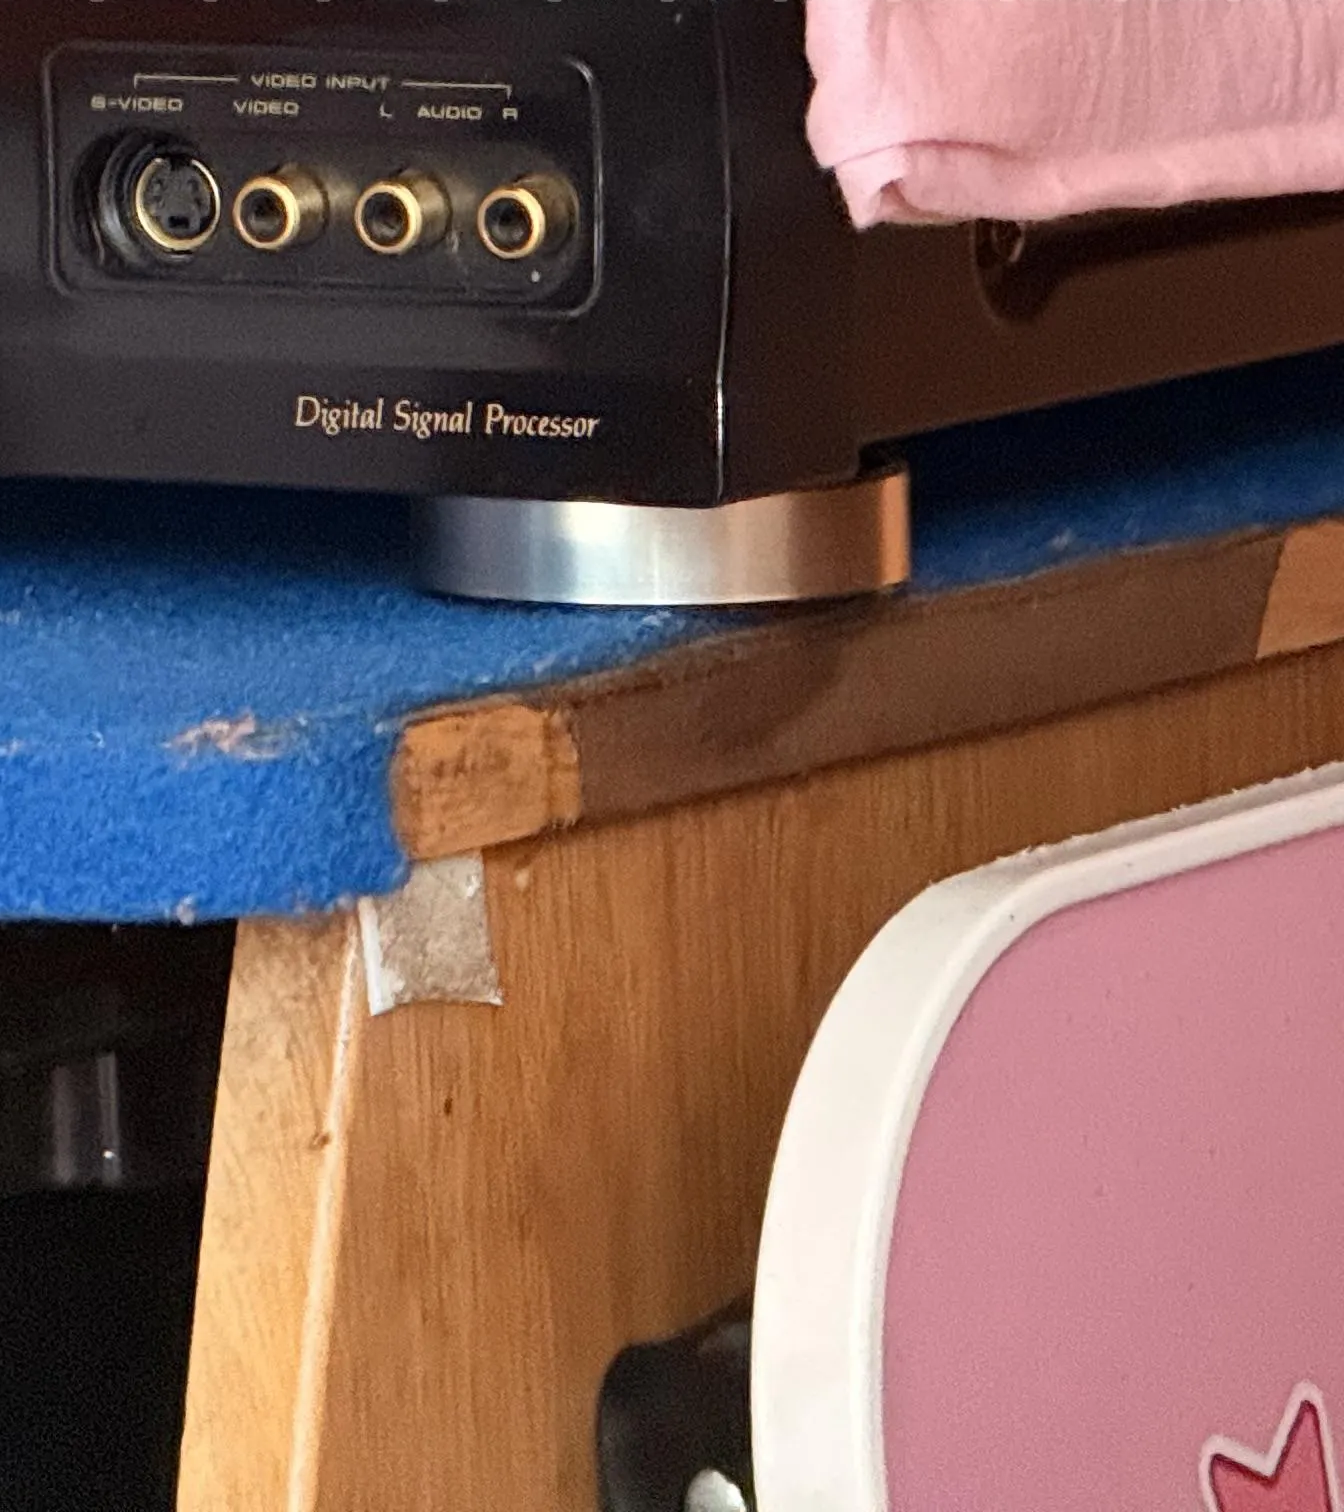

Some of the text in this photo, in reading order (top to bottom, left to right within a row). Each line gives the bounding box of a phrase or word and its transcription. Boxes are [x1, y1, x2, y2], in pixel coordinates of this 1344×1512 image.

[250, 73, 390, 91] VIDEO INPUT
[90, 95, 184, 113] S-VIDEO
[232, 99, 300, 116] VIDEO
[379, 104, 519, 121] L AUDIO R
[295, 395, 601, 440] Digital Signal Processor
